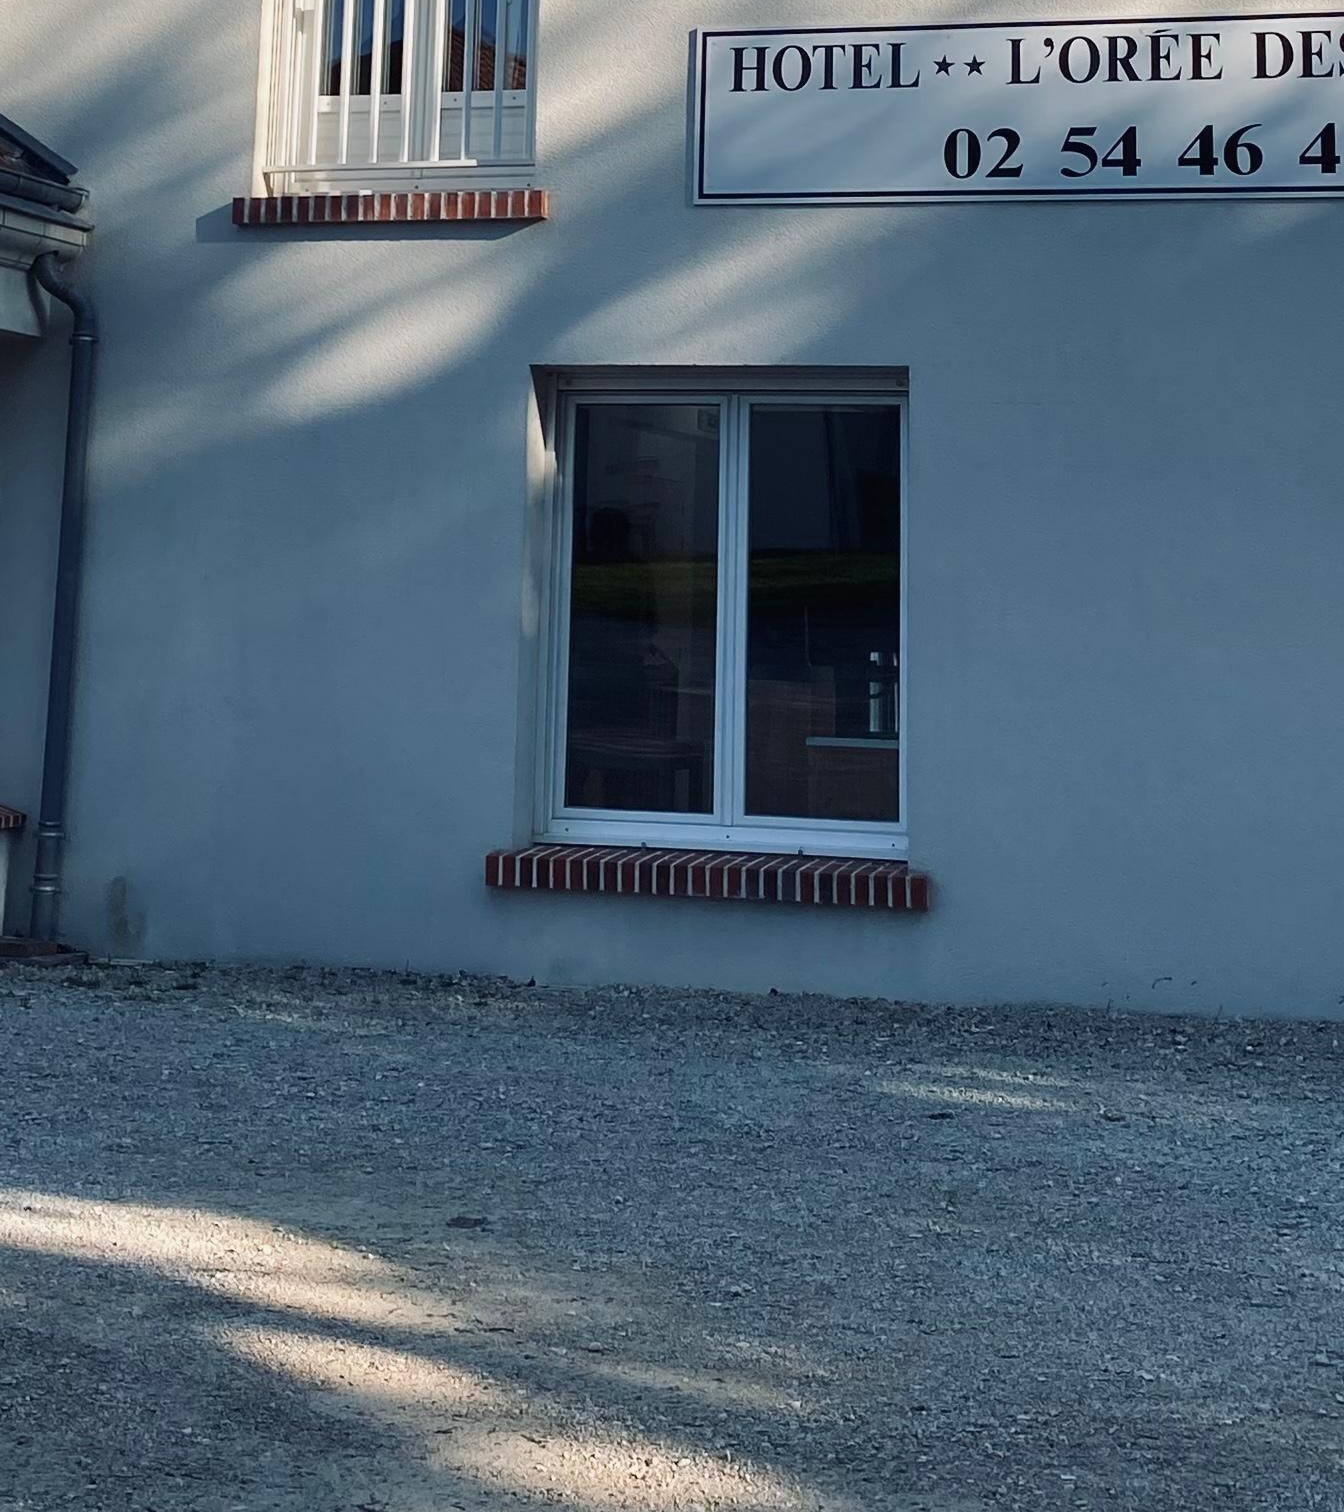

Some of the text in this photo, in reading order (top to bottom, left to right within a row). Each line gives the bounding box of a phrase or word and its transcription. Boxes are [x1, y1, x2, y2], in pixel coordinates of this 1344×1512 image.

[729, 42, 921, 93] HOTEL
[943, 127, 1024, 179] 02
[1060, 125, 1142, 178] 54
[1177, 123, 1263, 176] 46
